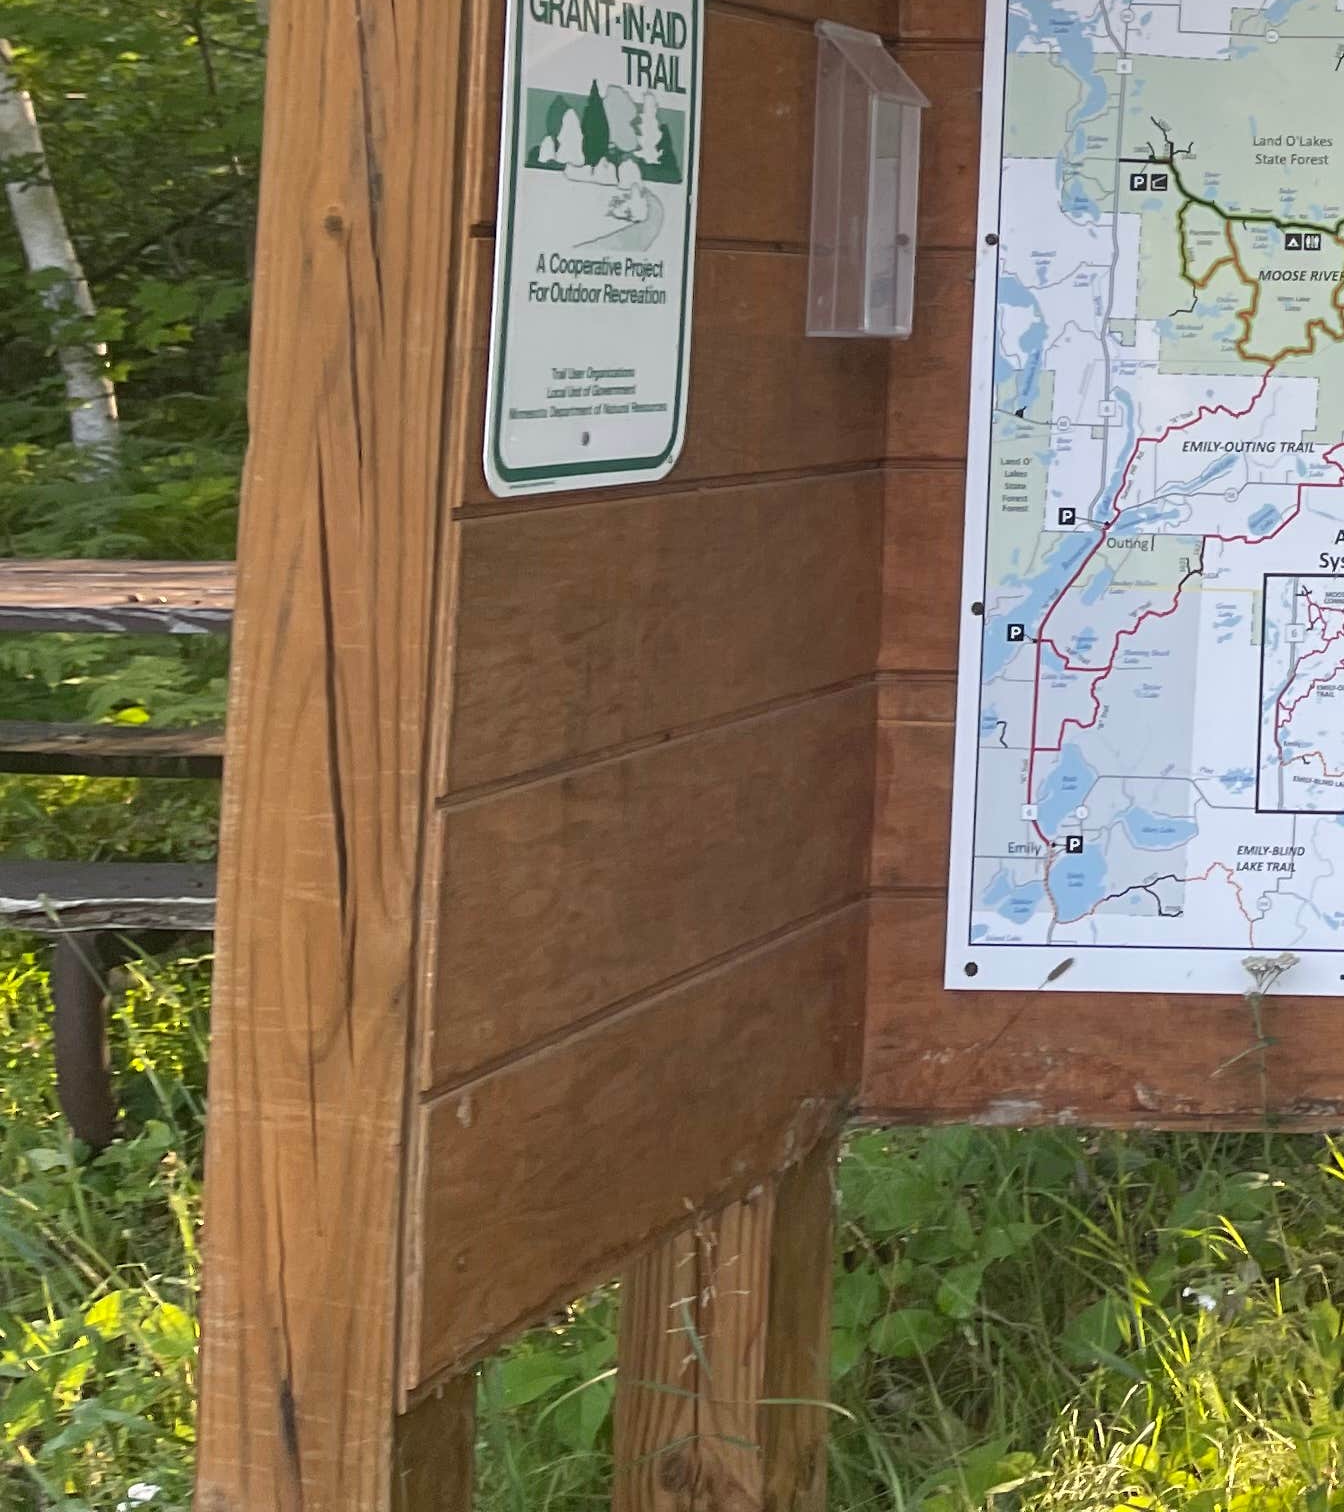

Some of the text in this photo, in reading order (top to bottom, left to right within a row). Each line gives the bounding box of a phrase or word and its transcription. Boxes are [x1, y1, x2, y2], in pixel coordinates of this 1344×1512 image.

[621, 46, 686, 94] TRAIL
[1253, 136, 1283, 147] Land
[1256, 154, 1328, 165] State Forest
[536, 253, 664, 281] A Cooperative Project
[1258, 270, 1306, 281] MOOSE
[529, 282, 666, 304] For Outdoor Recreation
[1182, 442, 1316, 454] EMILY-OUTING TRAIL
[1106, 538, 1148, 550] Outing
[1008, 842, 1042, 855] Emily
[1237, 846, 1305, 857] EMILY-BLIND
[1236, 862, 1296, 873] LAKE TRAIL
